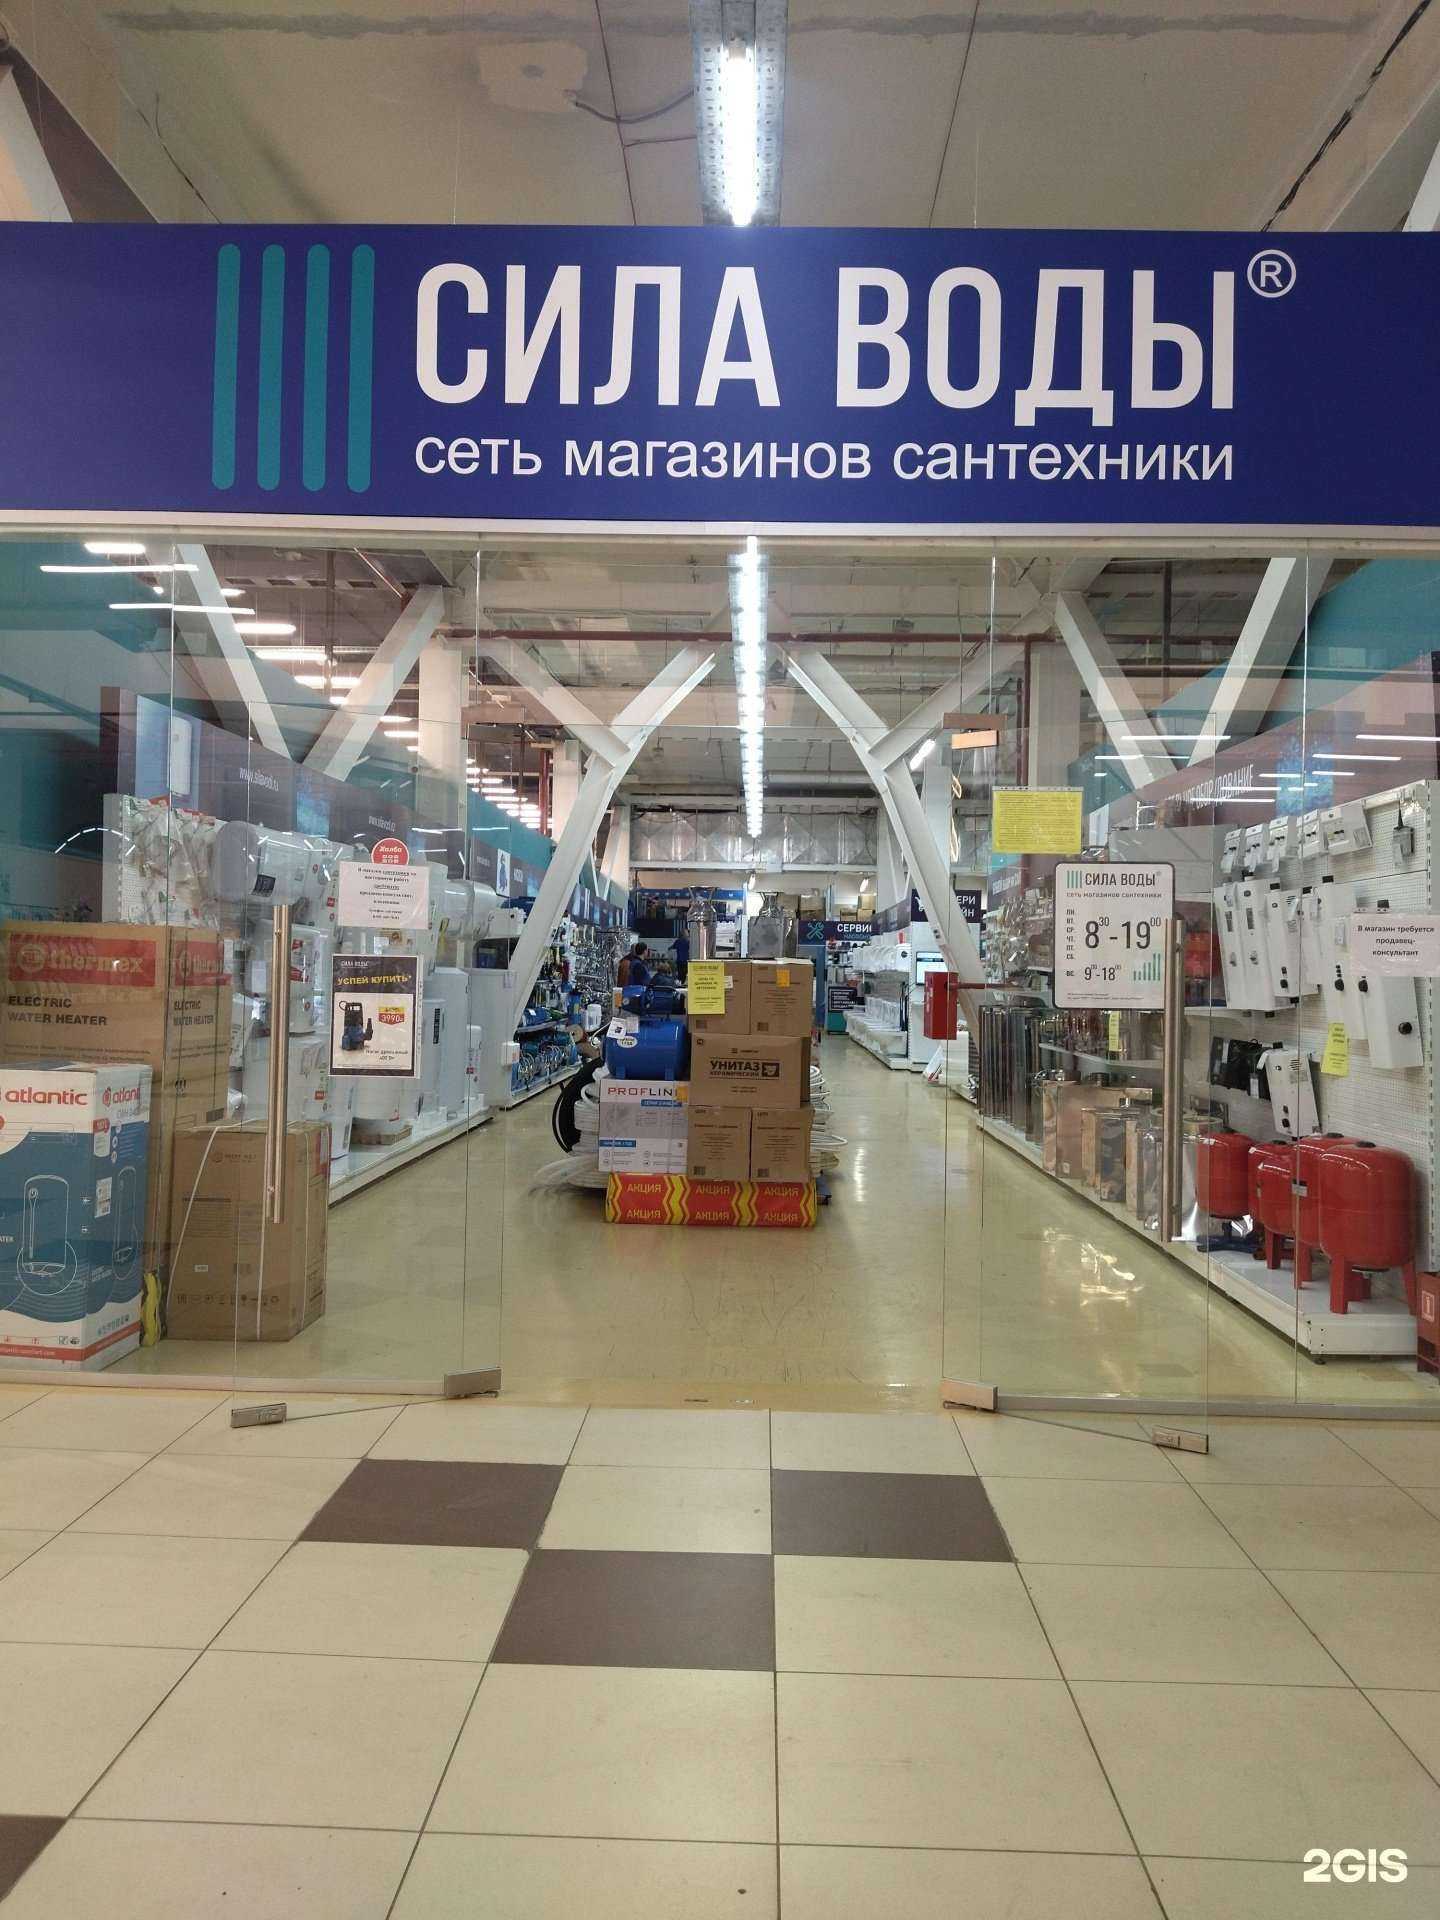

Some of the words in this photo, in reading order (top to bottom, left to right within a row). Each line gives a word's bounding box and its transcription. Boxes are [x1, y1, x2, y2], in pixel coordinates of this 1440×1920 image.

[416, 262, 781, 407] СИЛА
[836, 266, 1235, 427] ВОДЫ
[415, 435, 543, 475] сеть
[564, 439, 871, 480] магазинов
[893, 442, 1233, 481] сантехники
[1085, 873, 1117, 886] СИЛА
[1121, 873, 1155, 888] ВОДЫ
[1397, 925, 1435, 933] требуется
[47, 952, 144, 974] thermex
[337, 976, 369, 986] УСПЕЙ
[8, 995, 73, 1008] ELECTRIC
[174, 1000, 201, 1010] ELECTRIC
[8, 1012, 52, 1024] WATER
[56, 1014, 108, 1026] HEATER
[710, 1060, 760, 1071] УНИТАЗ
[4, 1086, 88, 1106] atlantic
[608, 1087, 678, 1097] PROFLIN
[626, 1183, 662, 1194] АКЦИЯ
[695, 1185, 730, 1196] АКЦИЯ
[764, 1187, 799, 1197] АКЦИЯ
[626, 1210, 661, 1220] АКЦИЯ
[695, 1211, 730, 1222] АКЦИЯ
[764, 1212, 799, 1223] АКЦИЯ
